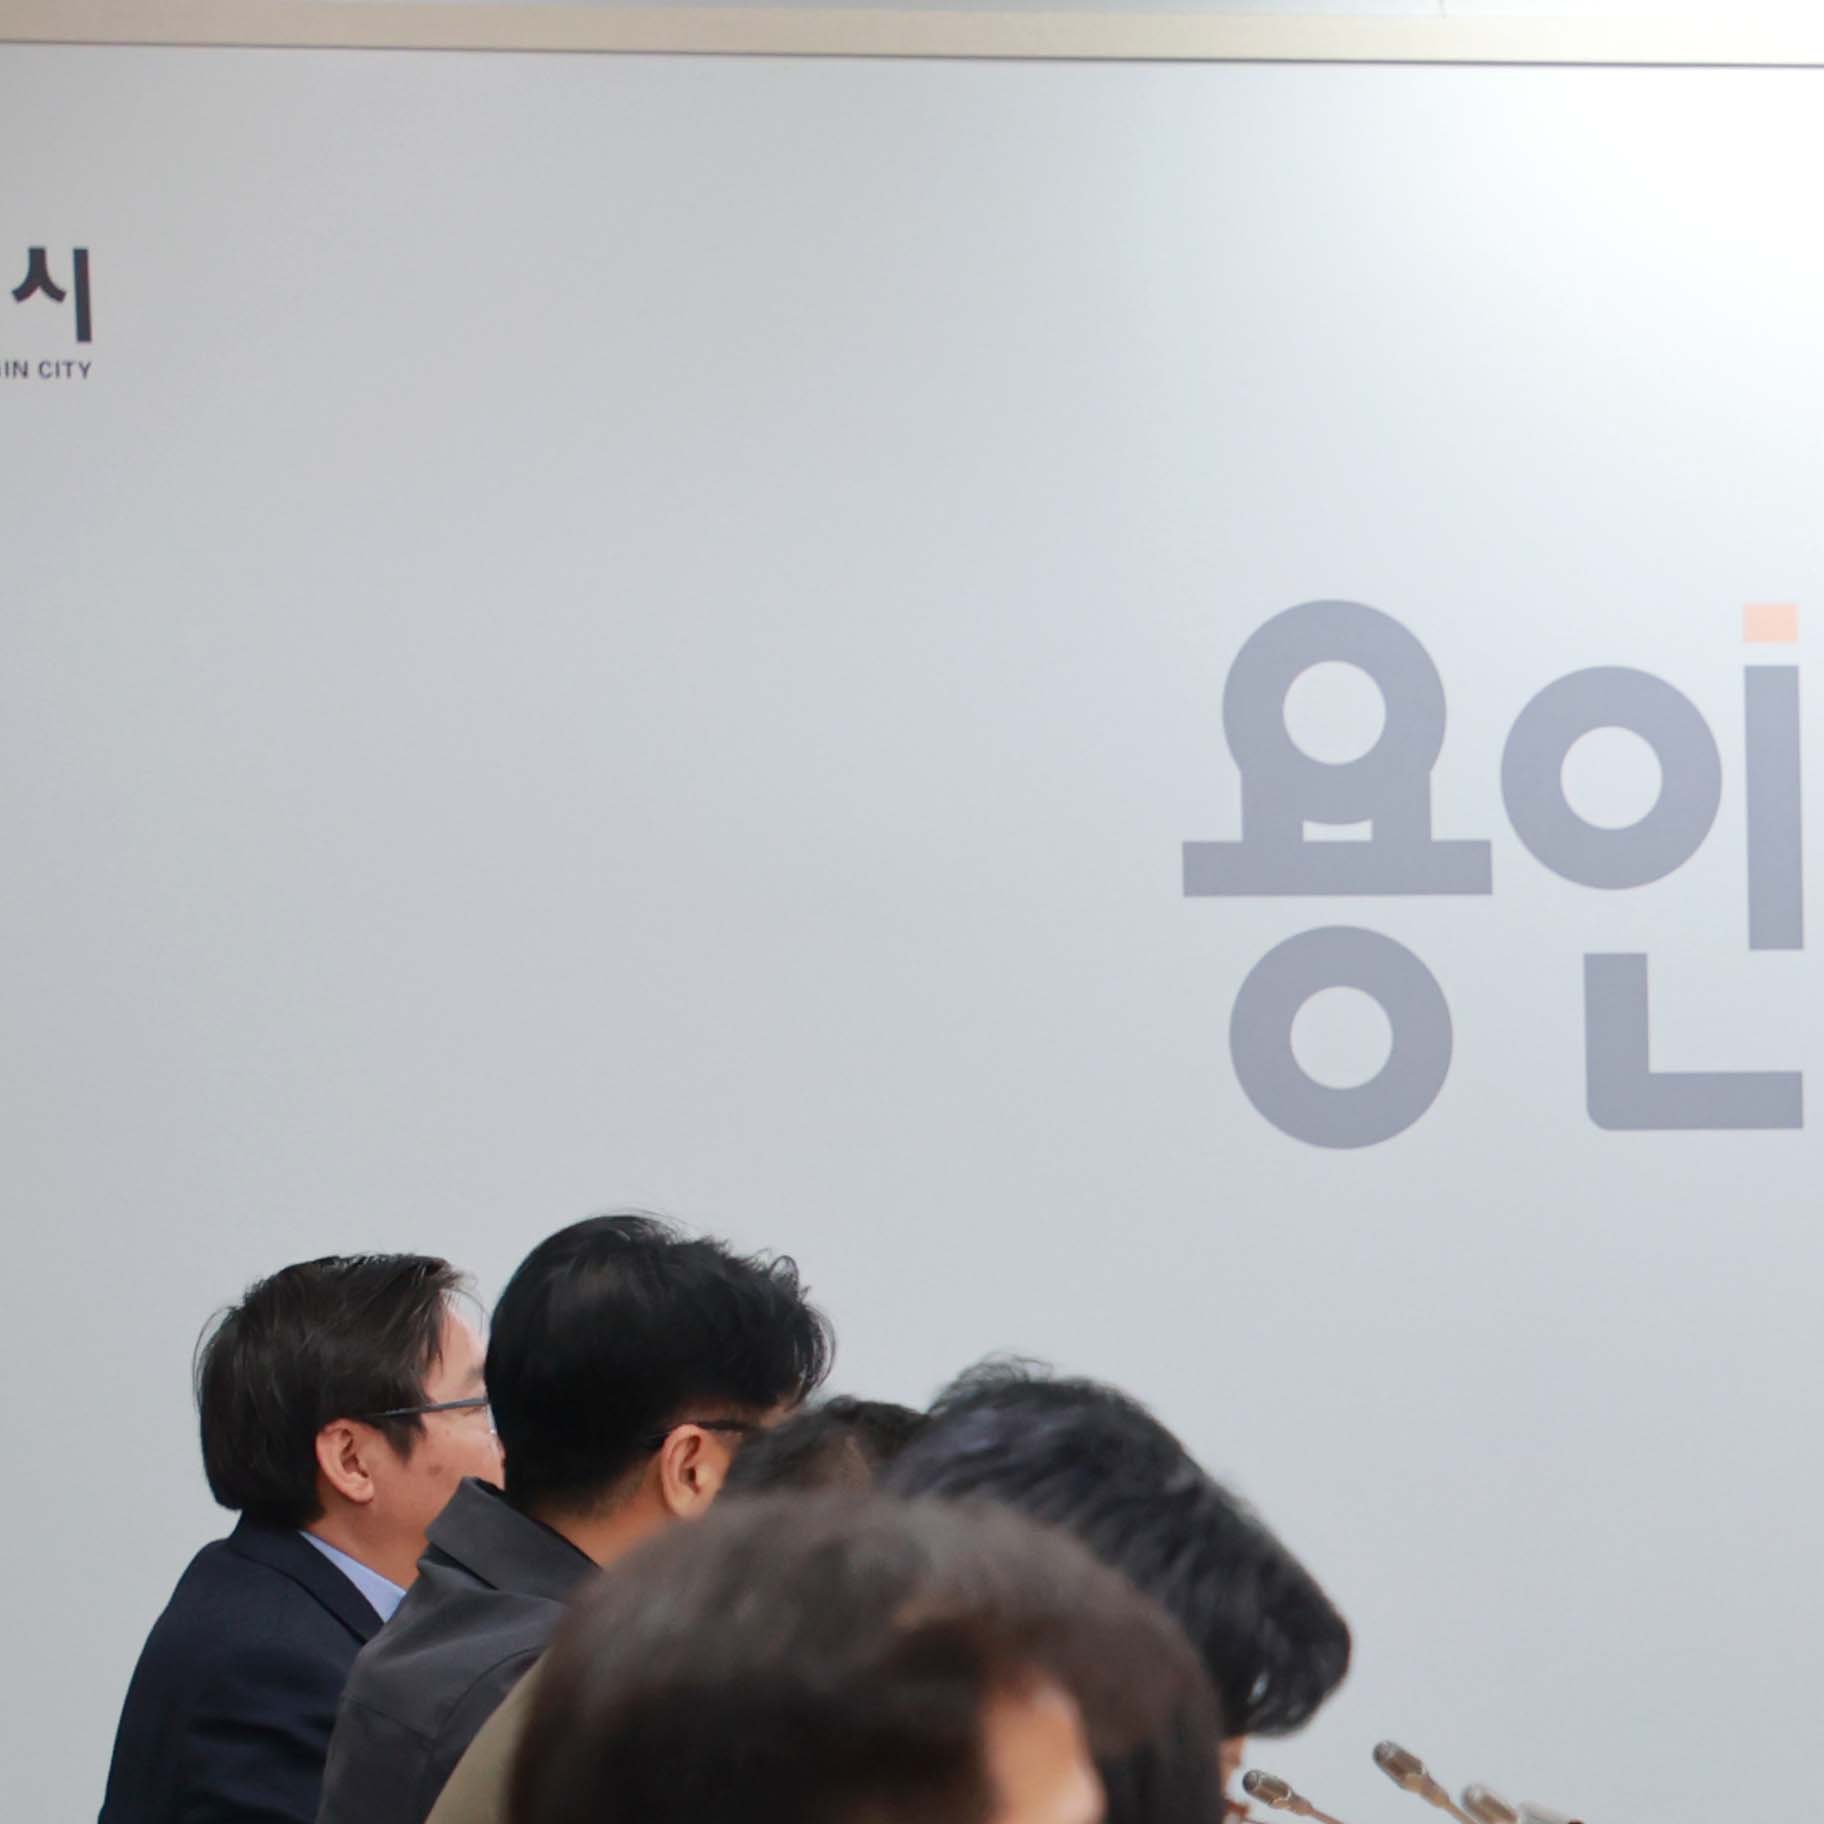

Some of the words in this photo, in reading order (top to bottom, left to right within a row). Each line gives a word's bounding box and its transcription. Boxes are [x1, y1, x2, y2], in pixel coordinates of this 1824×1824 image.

[11, 246, 92, 343] 시
[0, 361, 28, 379] IN
[38, 361, 92, 380] CITY
